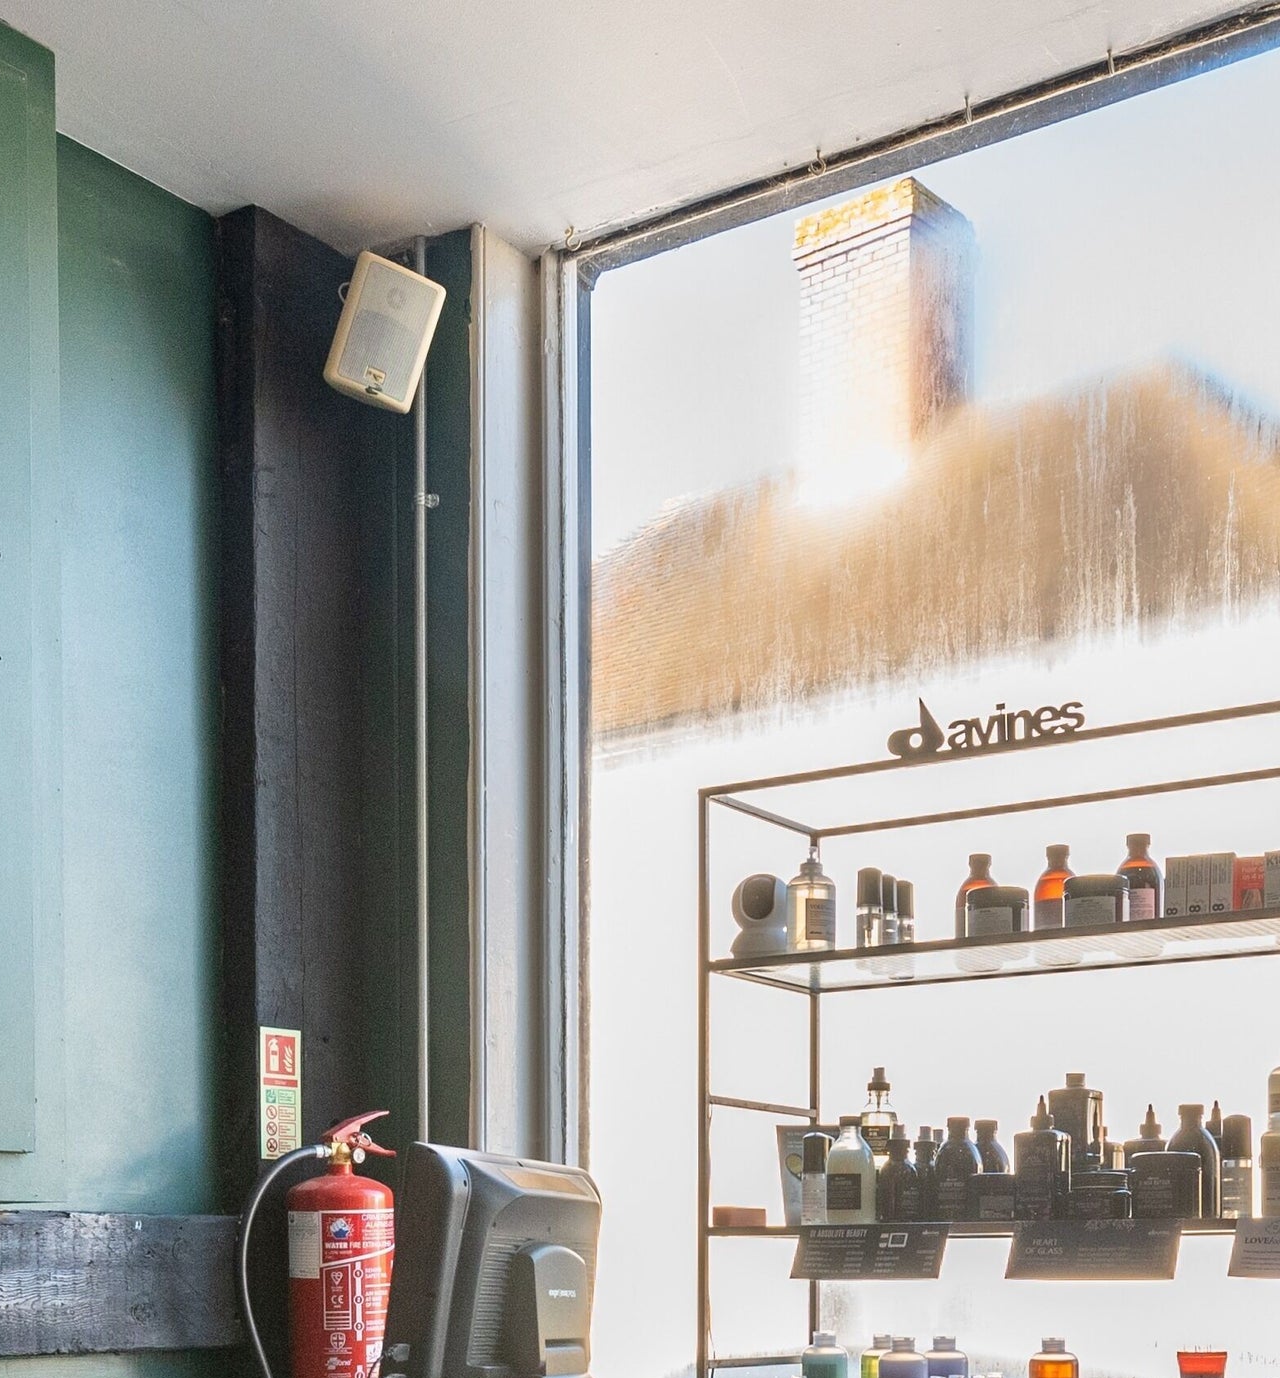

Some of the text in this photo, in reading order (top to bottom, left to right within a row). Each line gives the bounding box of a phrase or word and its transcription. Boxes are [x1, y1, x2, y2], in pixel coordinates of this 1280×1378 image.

[887, 697, 1085, 757] davines
[816, 1229, 845, 1238] ABSOLUTE
[846, 1228, 869, 1237] BEAUTY
[1032, 1238, 1058, 1246] HEART
[1025, 1247, 1063, 1256] OF GLASS
